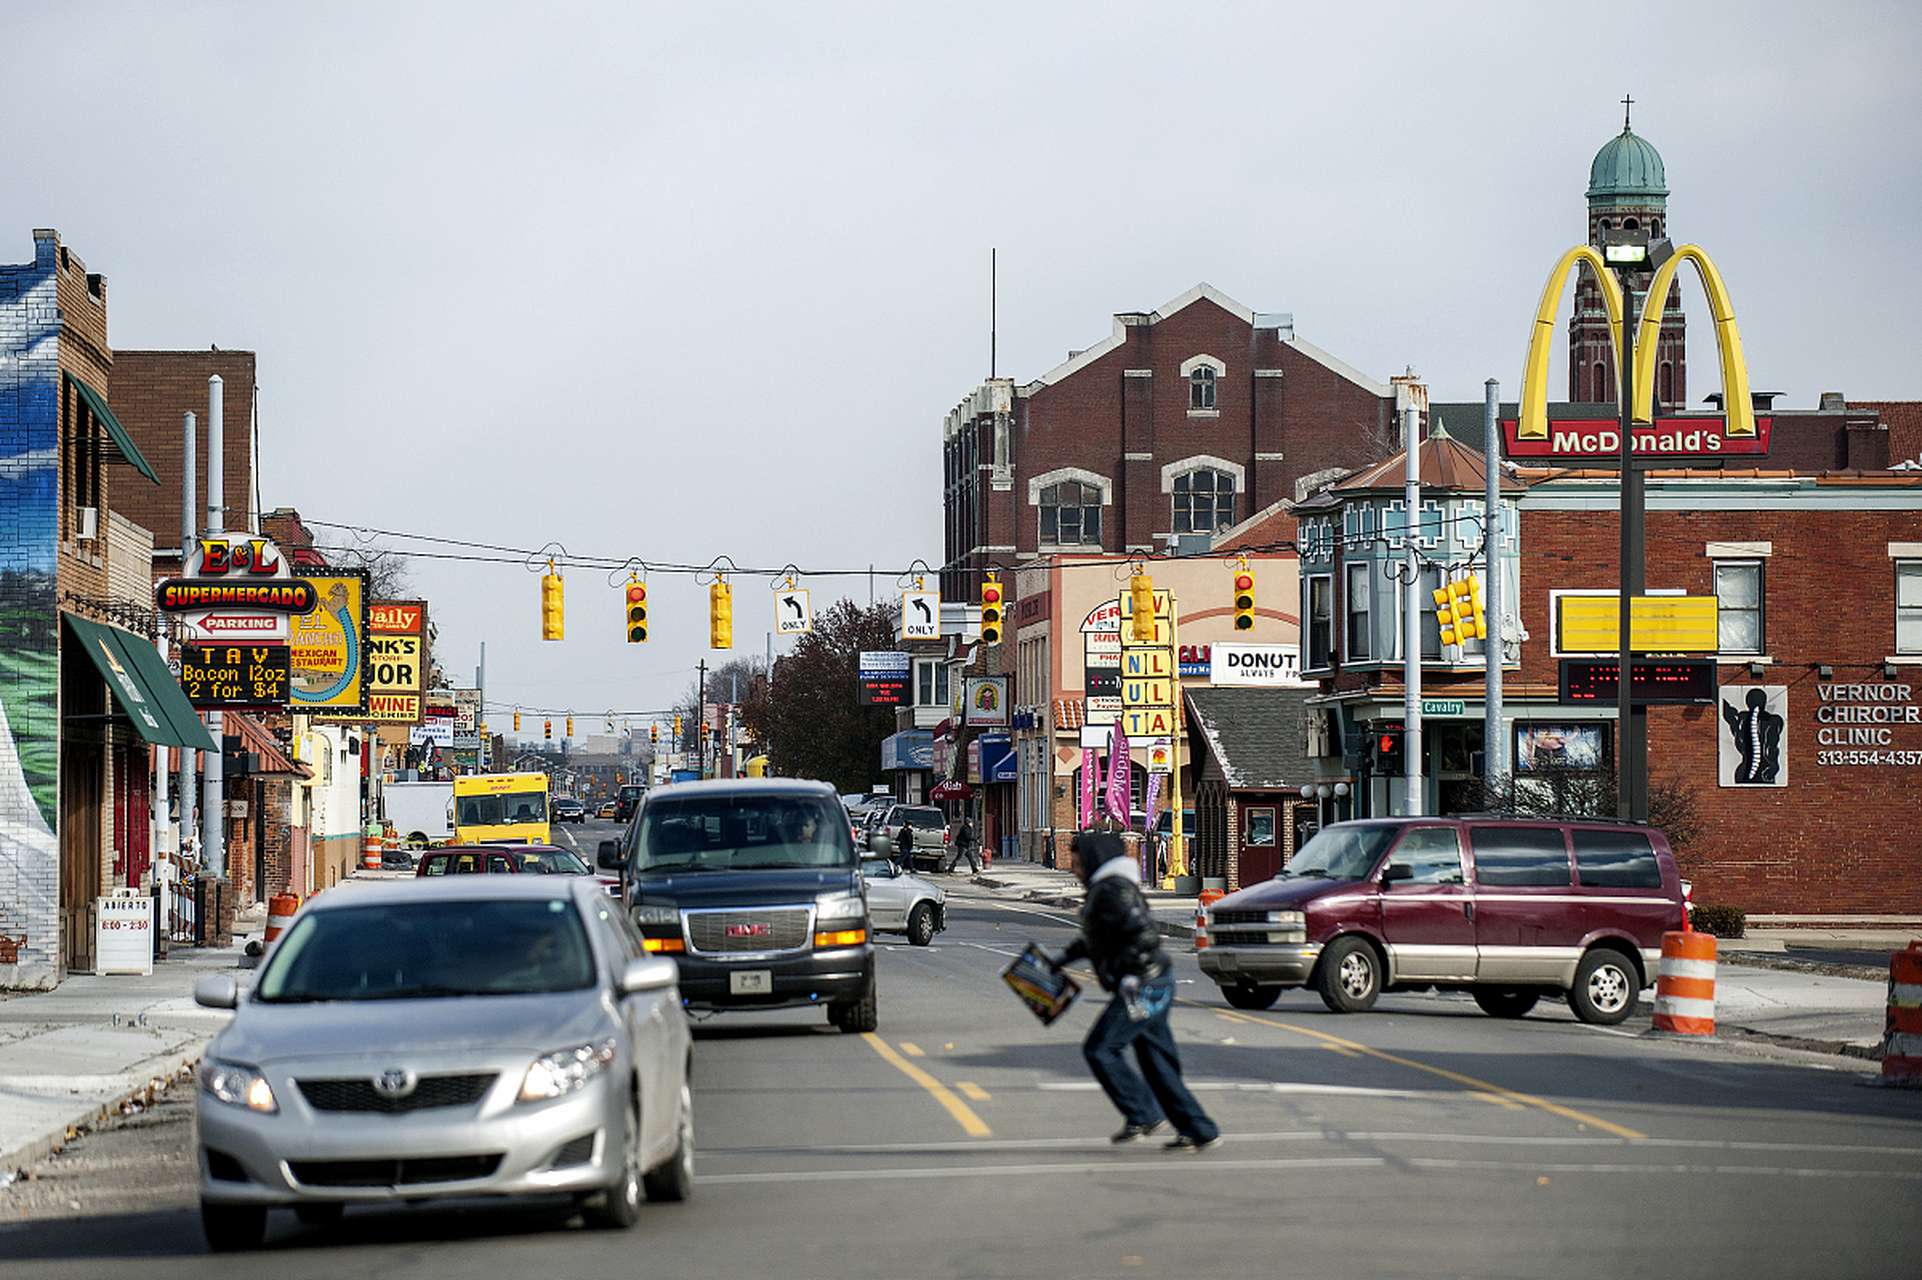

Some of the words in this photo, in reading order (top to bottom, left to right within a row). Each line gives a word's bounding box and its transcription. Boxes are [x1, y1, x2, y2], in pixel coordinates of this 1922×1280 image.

[200, 540, 278, 573] E&L
[165, 586, 307, 607] SUPERMERCADO
[206, 619, 274, 628] PARKING
[299, 613, 328, 629] EL
[781, 620, 806, 630] ONLY
[908, 626, 935, 635] ONLY
[291, 658, 343, 667] ESTAURANT
[1228, 653, 1297, 668] DONUT
[183, 664, 239, 681] Bacon
[249, 664, 286, 681] 12oz
[190, 682, 200, 698] 2
[211, 682, 242, 698] for
[254, 682, 279, 698] $4
[1817, 684, 1912, 701] VERNOR
[370, 697, 416, 711] WINE
[1424, 702, 1462, 715] Cavalry
[1817, 706, 1922, 723] CHIROPR
[1817, 728, 1892, 745] CLINIC
[1817, 750, 1922, 765] 313-554-4357
[104, 901, 148, 910] ABIERTO
[727, 924, 772, 936] GMC
